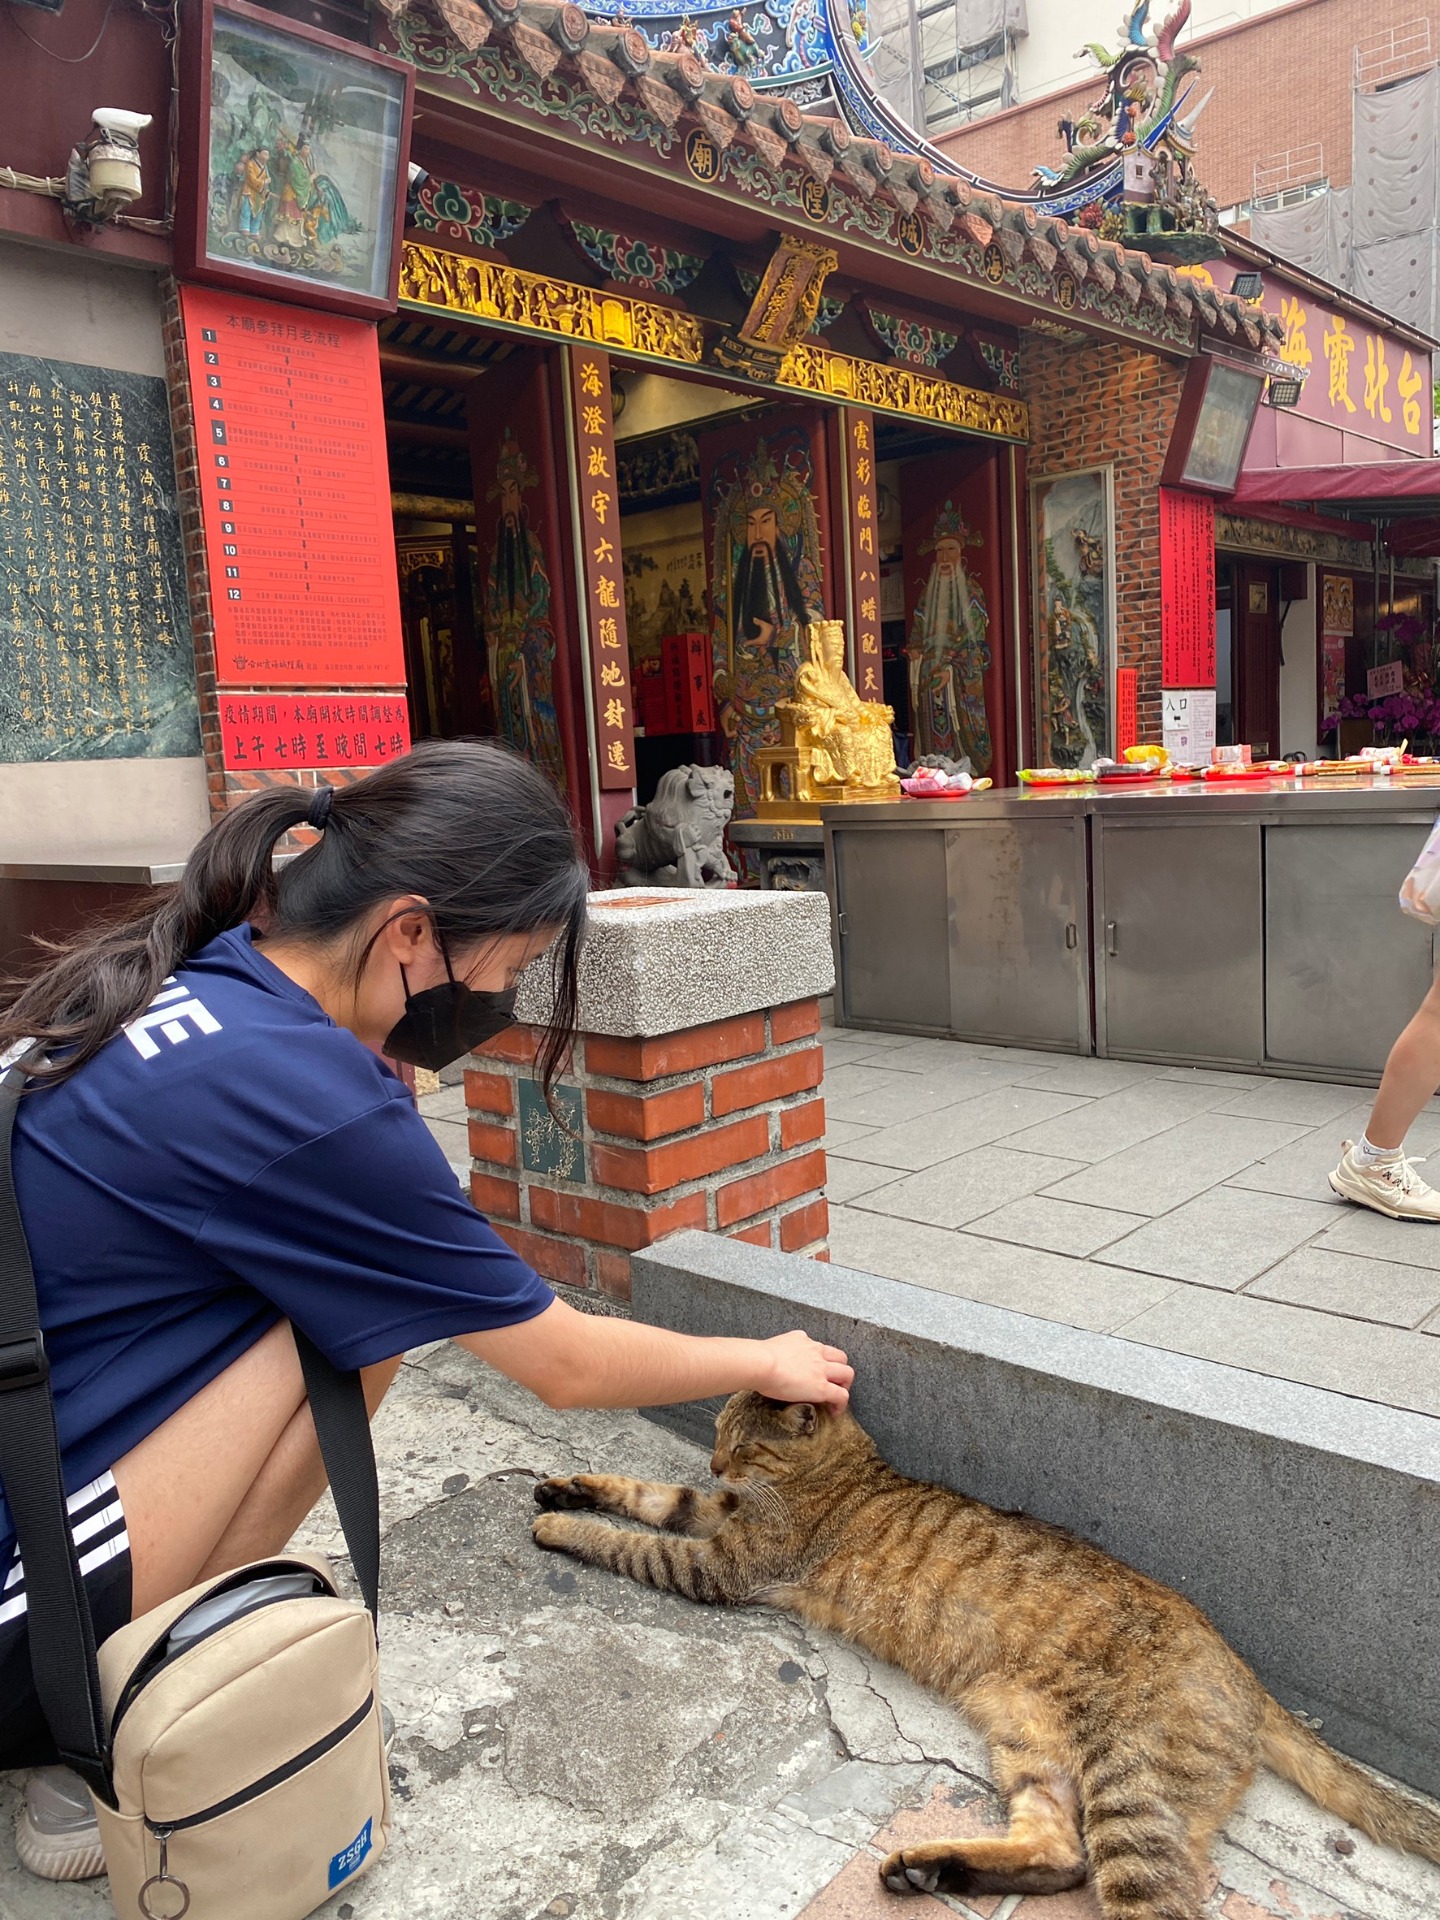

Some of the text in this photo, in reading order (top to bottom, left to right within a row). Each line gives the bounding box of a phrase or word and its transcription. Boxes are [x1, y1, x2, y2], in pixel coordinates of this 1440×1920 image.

[226, 313, 342, 349] 本廟參拜月老流程
[207, 332, 211, 340] 1
[209, 354, 215, 363] 2
[211, 377, 217, 386] 3
[213, 400, 219, 408] 4
[216, 428, 222, 437] 5
[219, 457, 225, 465] 6
[221, 479, 227, 488] 7
[223, 502, 229, 510] 8
[225, 524, 231, 532] 9
[225, 546, 235, 555] 10
[853, 420, 879, 704] 霞彩臨門八蜡配天
[227, 568, 236, 576] 11
[229, 590, 239, 598] 12
[1166, 698, 1187, 711] 入口
[233, 734, 404, 763] 上午七時至晚間七時
[338, 1829, 367, 1871] ZSGH
